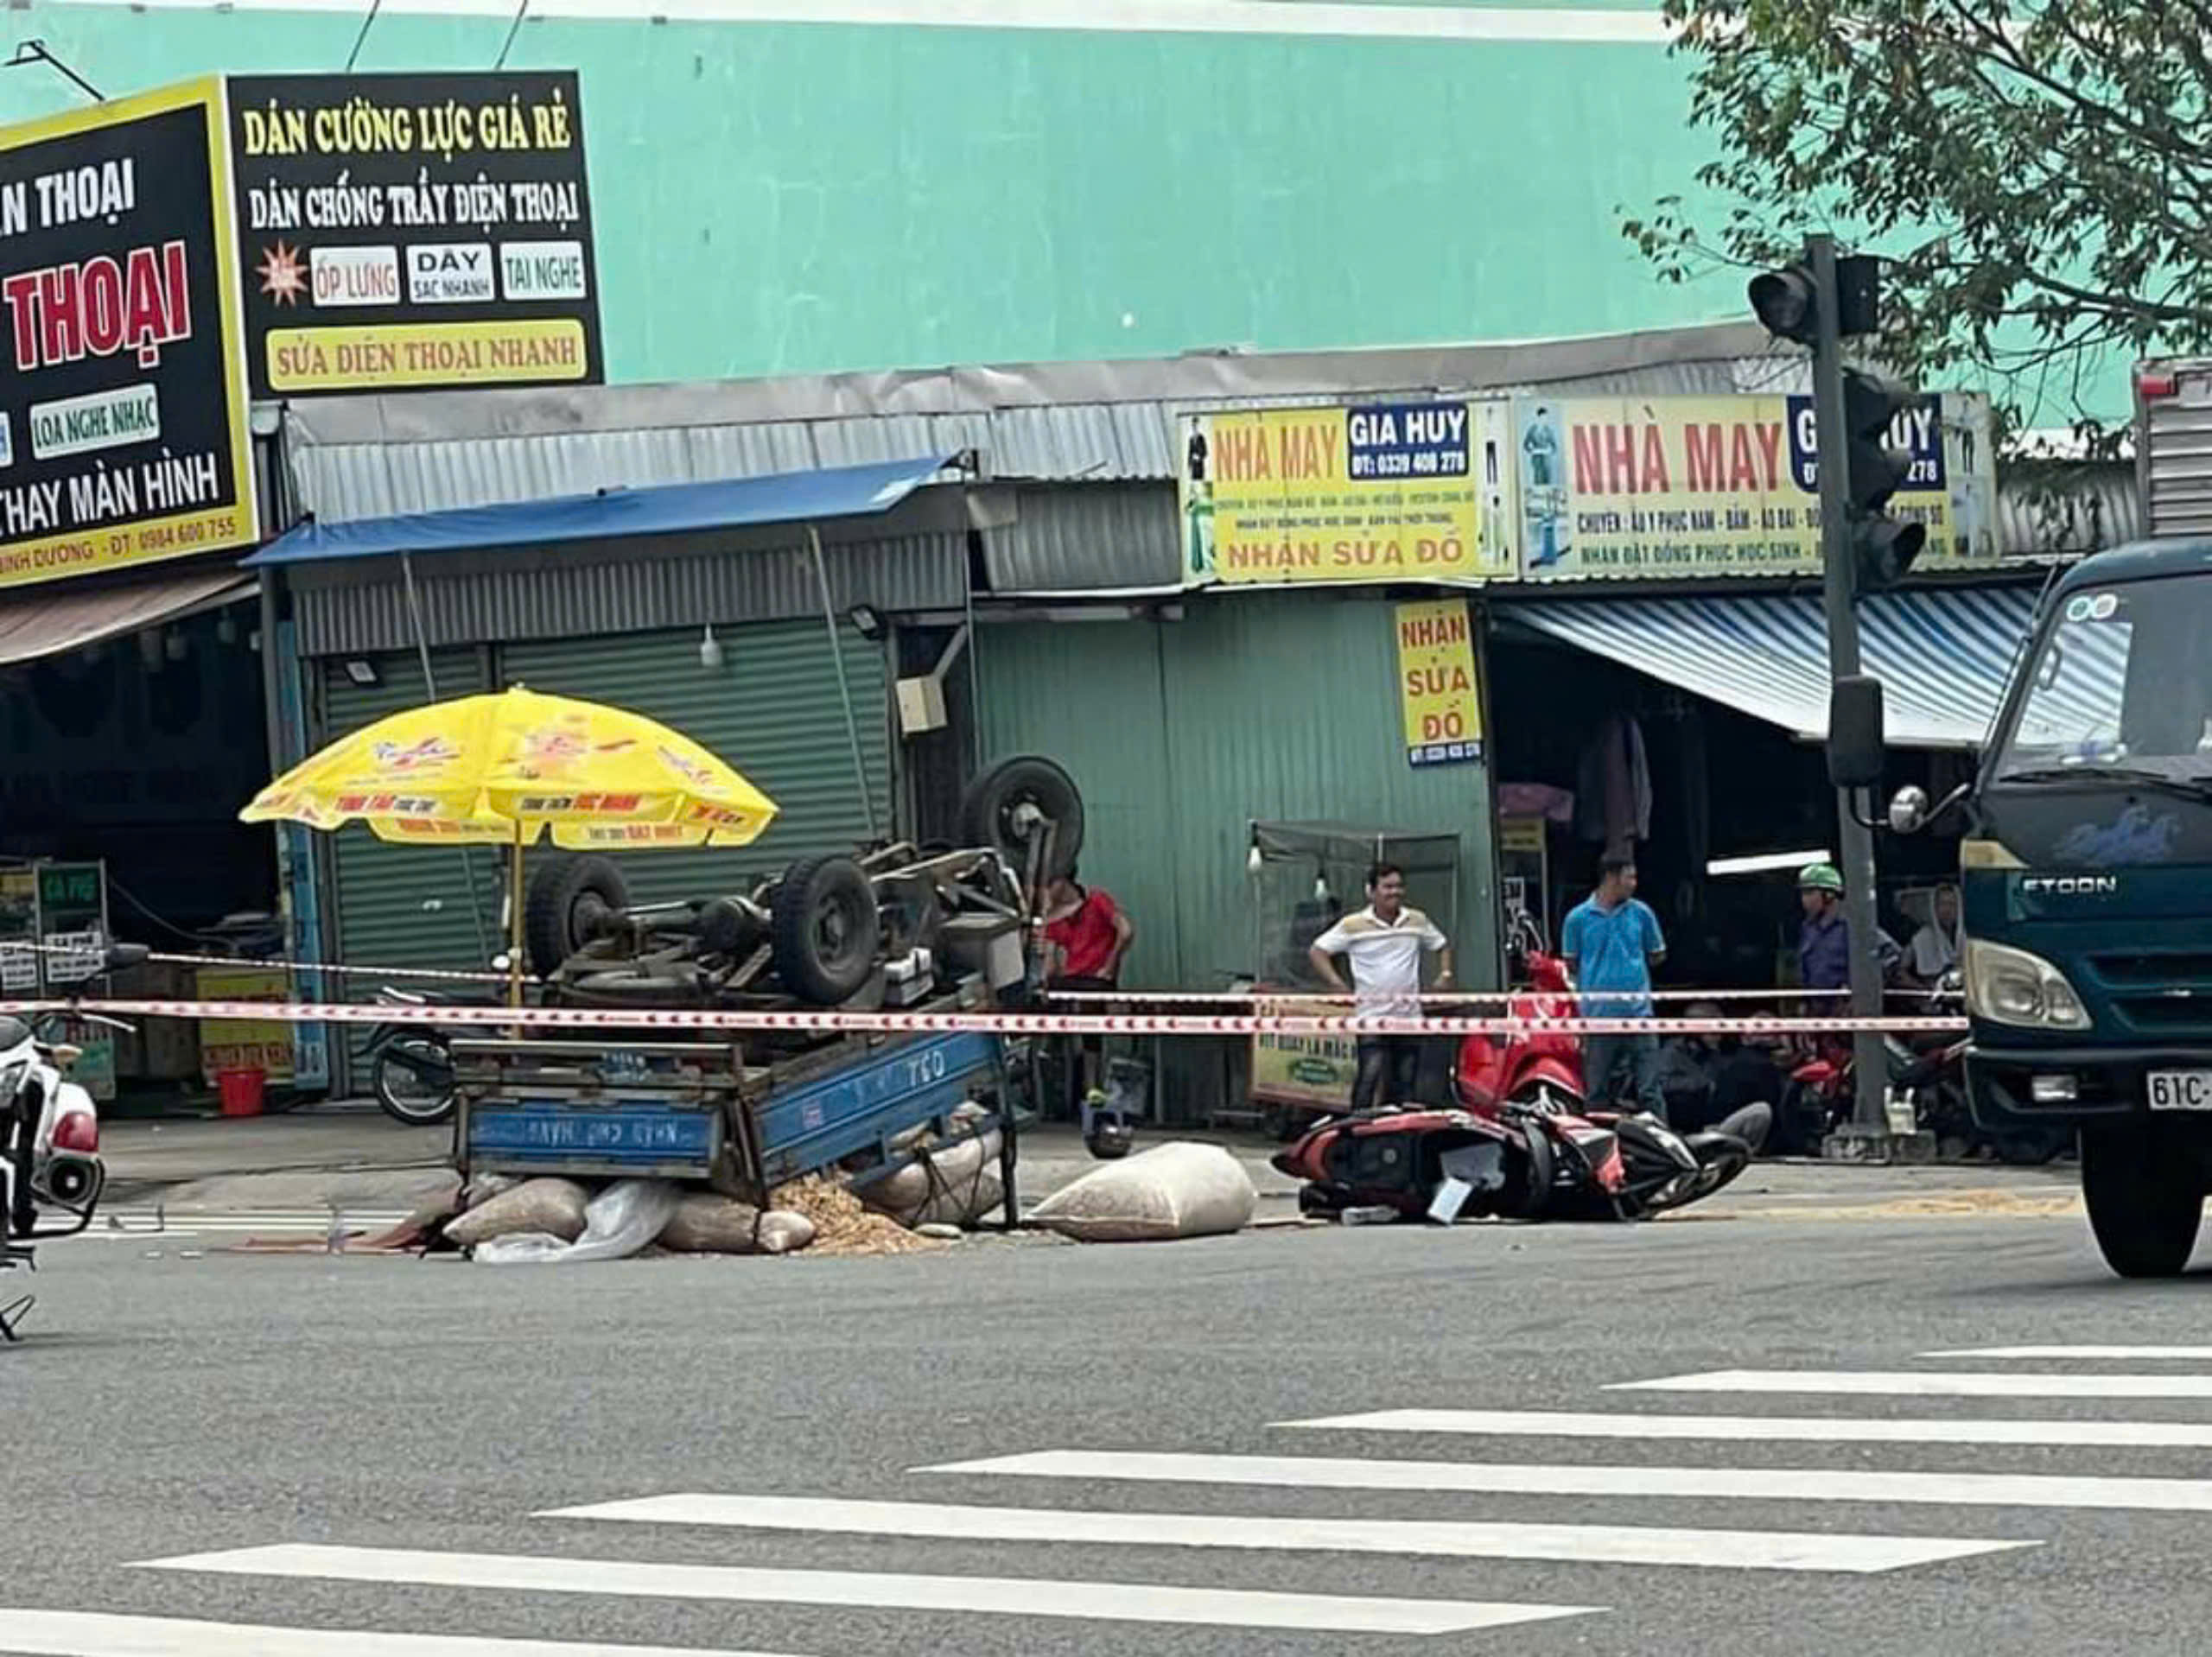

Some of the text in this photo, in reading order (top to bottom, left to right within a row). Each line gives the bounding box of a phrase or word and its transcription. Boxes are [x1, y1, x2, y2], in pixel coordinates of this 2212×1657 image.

[244, 87, 571, 162] DÁN CƯỜNG LỰC GIÁ RẺ
[35, 157, 135, 225] THOẠI
[249, 178, 302, 230] DÁN
[305, 168, 384, 227] CHỐNG
[511, 181, 581, 232] THOẠI
[505, 255, 582, 289] TAI NGHE
[4, 239, 191, 371] THOẠI
[404, 340, 481, 378] THOẠI
[489, 335, 576, 368] NHANH
[34, 414, 64, 449] LOA
[66, 404, 109, 443] NGHE
[1280, 425, 1336, 479] MAY
[1351, 408, 1465, 446] GIA HUY
[1573, 405, 1670, 494] NHÀ
[1686, 422, 1783, 492] MAY
[69, 459, 137, 524] MÀN
[143, 447, 218, 511] HÌNH
